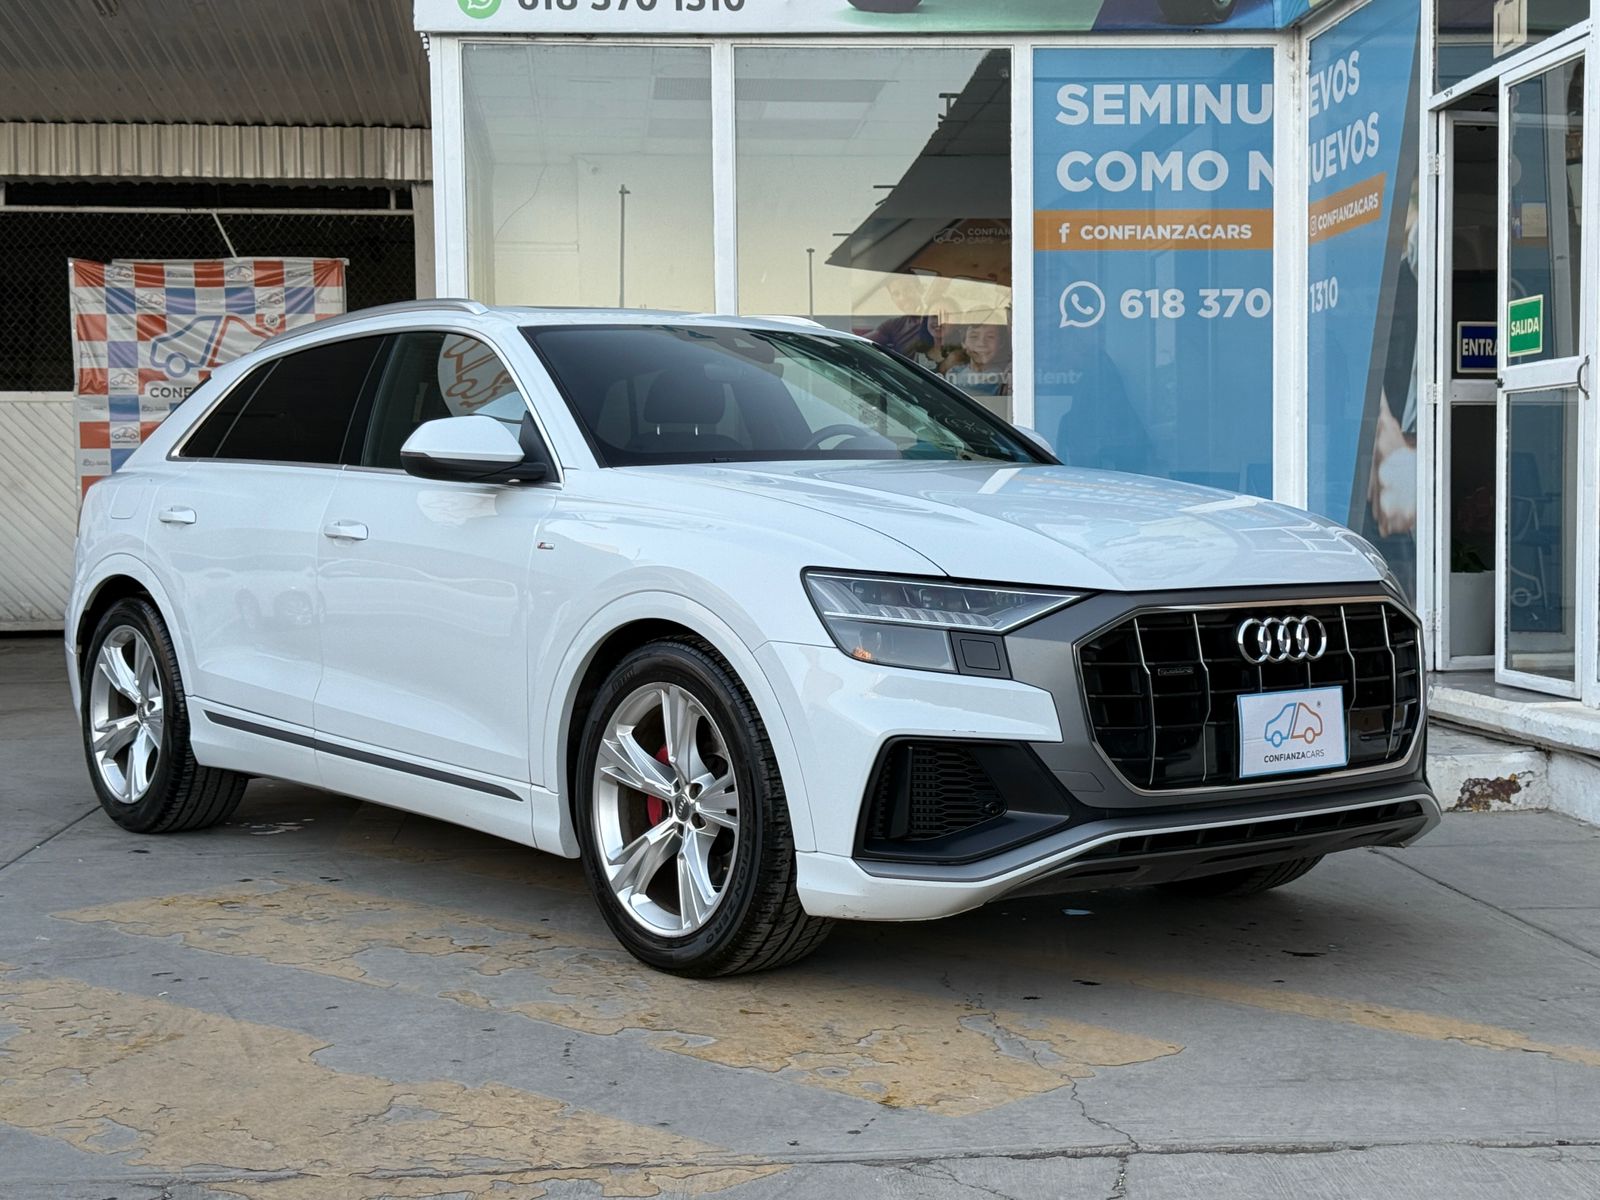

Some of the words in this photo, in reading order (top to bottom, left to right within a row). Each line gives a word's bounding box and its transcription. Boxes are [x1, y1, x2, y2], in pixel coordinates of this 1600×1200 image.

[1055, 83, 1273, 126] SEMINU
[1308, 111, 1380, 186] UEVOS
[1056, 150, 1229, 192] COMO
[1317, 192, 1379, 231] CONFIANZACARS
[1080, 224, 1252, 240] CONFIANZACARS
[1120, 288, 1185, 319] 618
[1197, 288, 1272, 319] 370
[1309, 276, 1339, 314] 1310
[1510, 316, 1540, 337] SALIDA
[1263, 749, 1325, 763] CONFIANZACARS
